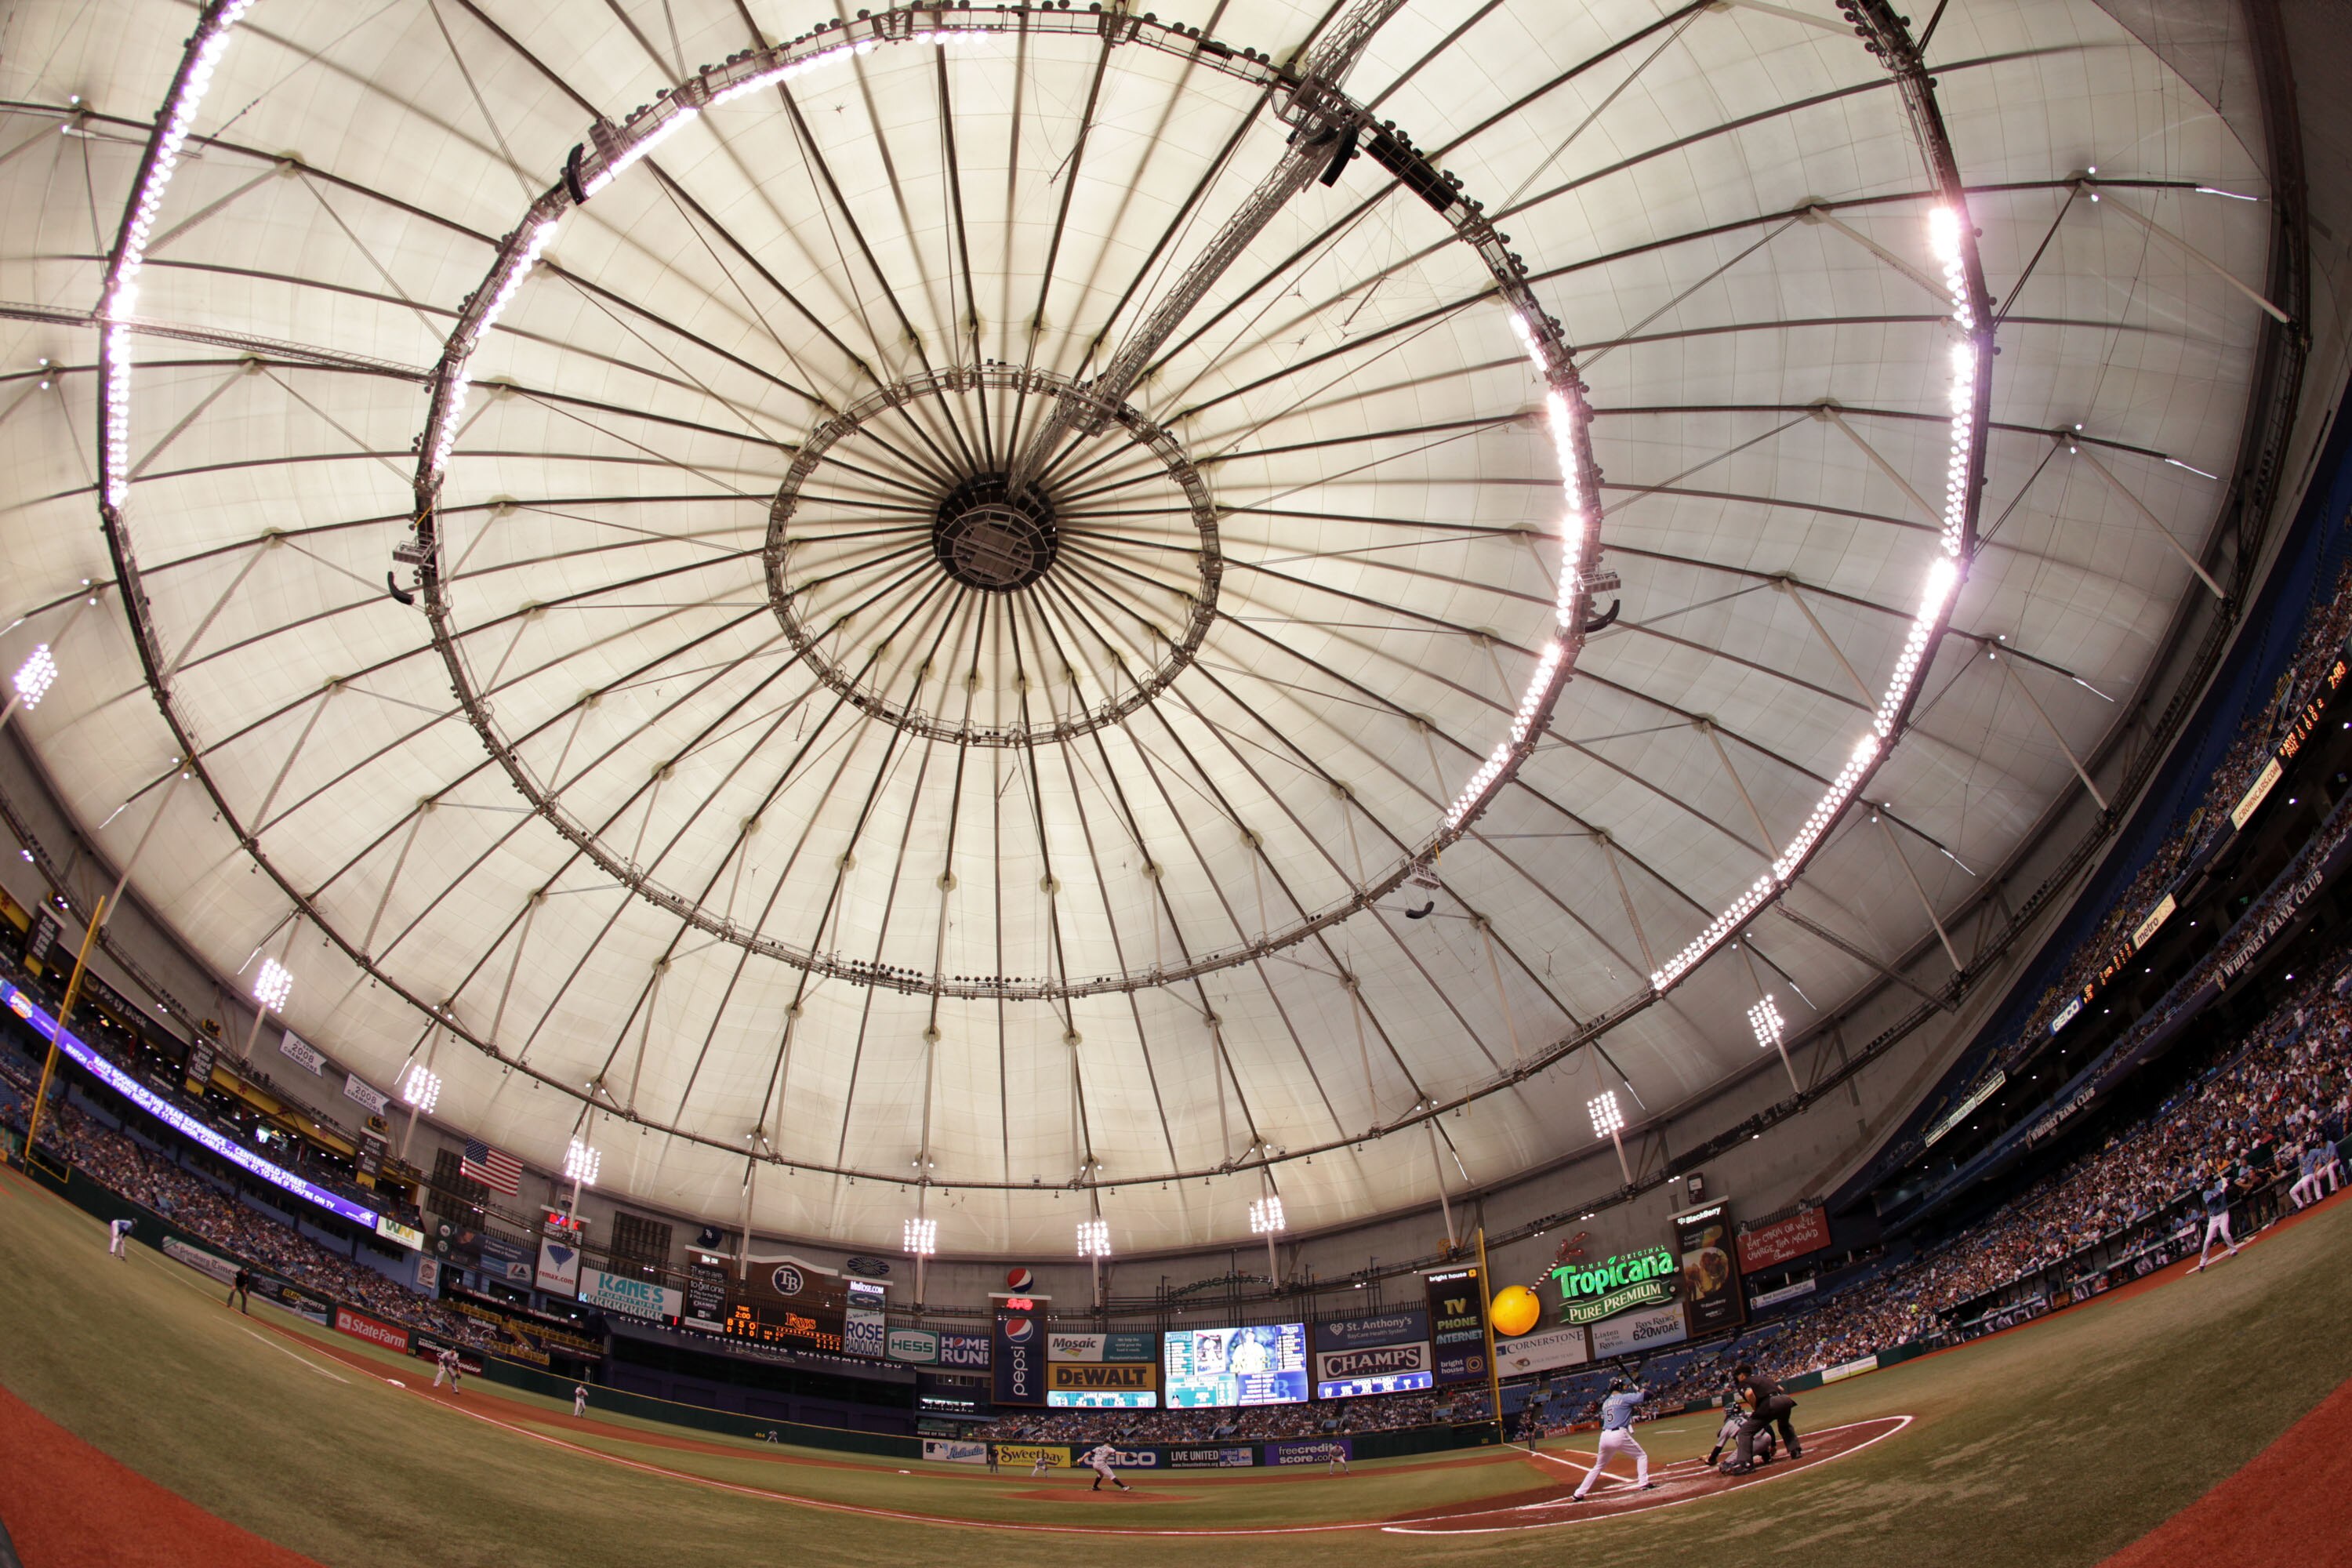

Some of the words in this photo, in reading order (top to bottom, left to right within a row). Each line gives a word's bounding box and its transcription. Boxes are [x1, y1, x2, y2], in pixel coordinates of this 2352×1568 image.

[2328, 660, 2347, 689] 2:00
[2238, 764, 2280, 821] CROWNCARS.COM
[2223, 927, 2267, 978] WHITNEY
[2267, 901, 2296, 936] BANK
[2296, 870, 2323, 904] CLUB
[2052, 1000, 2079, 1033] GEICO
[282, 1045, 318, 1073] CHAMPIONS
[291, 1043, 315, 1064] 2008
[347, 1088, 381, 1113] CHAMPIONS
[354, 1085, 378, 1105] 2008
[2031, 1112, 2059, 1141] WHITNEY
[2077, 1087, 2096, 1106] CLUB
[111, 1069, 140, 1092] ROOKIE
[149, 1094, 165, 1111] THE
[164, 1103, 184, 1122] YEAR
[183, 1116, 228, 1147] EXPERIENCE
[234, 1146, 281, 1176] CENTERFIELD
[281, 1171, 309, 1190] STREET
[199, 1134, 222, 1152] CABLE
[220, 1145, 251, 1168] CHANNEL
[289, 1182, 315, 1200] YOU'RE
[313, 1193, 326, 1206] ON
[325, 1200, 336, 1210] TV
[1686, 1206, 1722, 1224] BlackBerry
[1747, 1237, 1761, 1251] EAT
[1762, 1228, 1783, 1243] CHIKIN
[1784, 1223, 1795, 1234] OR
[1747, 1245, 1776, 1261] CHARGE
[1776, 1236, 1790, 1251] THA
[1791, 1229, 1820, 1245] MOUND
[1580, 1261, 1602, 1271] THE
[1620, 1244, 1667, 1261] ORIGINAL
[539, 1269, 575, 1286] remax.com
[777, 1270, 799, 1291] TB
[1428, 1274, 1448, 1283] bright
[1552, 1251, 1675, 1299] Tropicana
[598, 1272, 664, 1304] KANE'S
[710, 1285, 725, 1294] one.
[282, 1287, 302, 1301] SUN
[301, 1295, 327, 1311] SPORTS
[692, 1300, 717, 1310] CHAMPS
[1443, 1298, 1467, 1316] TV
[1569, 1304, 1602, 1322] PURE
[1602, 1283, 1662, 1313] PREMIUM
[727, 1317, 734, 1327] B
[735, 1311, 751, 1319] 2:00
[1347, 1323, 1360, 1331] St.
[1363, 1316, 1412, 1330] Anthony's
[1437, 1316, 1479, 1331] PHONE
[1635, 1319, 1653, 1330] Rays
[846, 1320, 884, 1342] ROSE
[1347, 1330, 1369, 1340] BayCare
[1388, 1327, 1408, 1336] System
[1436, 1329, 1484, 1345] INTERNET
[1594, 1329, 1619, 1340] Listen
[619, 1316, 648, 1327] CITY
[656, 1323, 673, 1332] OF
[706, 1334, 789, 1353] PETERSBURG
[796, 1349, 866, 1366] WELCOMES
[874, 1361, 902, 1370] YOU
[844, 1337, 884, 1359] RADIOLOGY
[891, 1338, 934, 1354] HESS
[1051, 1337, 1097, 1349] Mosaic
[1506, 1330, 1584, 1355] CORNERSTONE
[1599, 1341, 1614, 1350] Rays
[941, 1348, 990, 1366] RUN!
[1325, 1348, 1420, 1377] CHAMPS
[1440, 1359, 1465, 1370] bright
[1011, 1345, 1029, 1396] pepsi
[1606, 1408, 1614, 1424] 5
[946, 1444, 985, 1460] Authentic
[1000, 1446, 1064, 1464] Sweetbay
[1171, 1450, 1189, 1461] LIVE
[1189, 1450, 1219, 1461] UNITED
